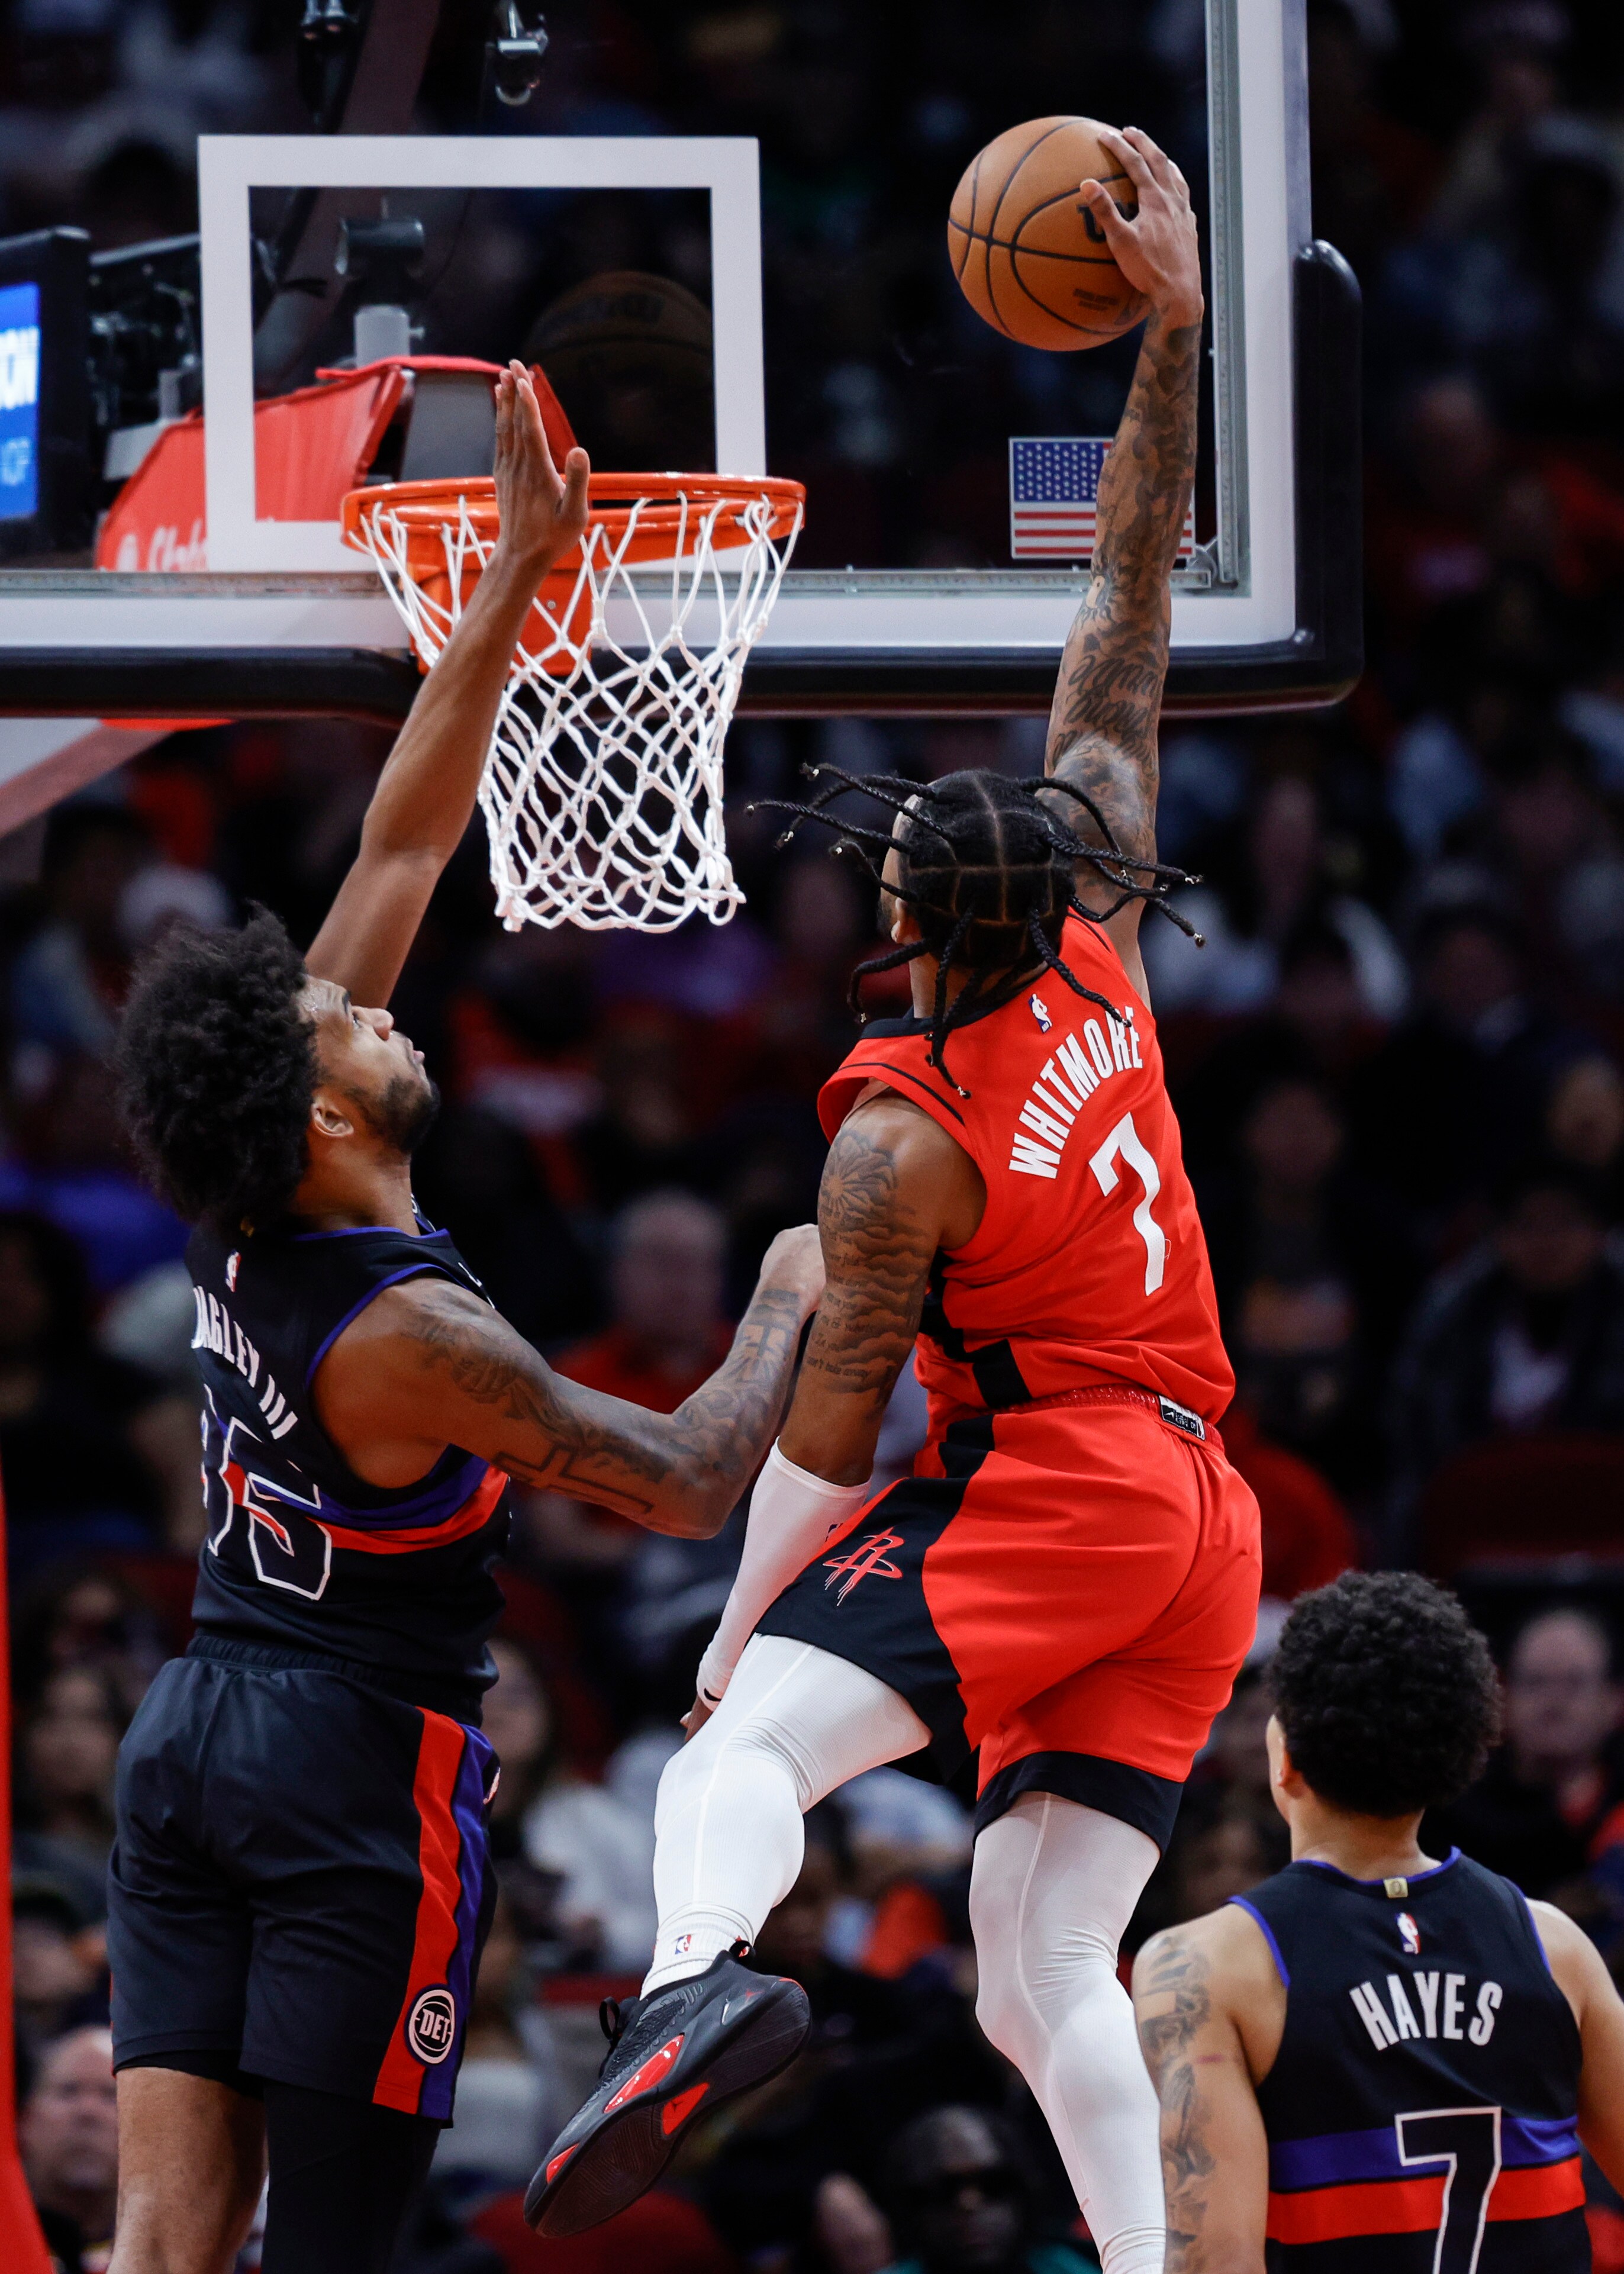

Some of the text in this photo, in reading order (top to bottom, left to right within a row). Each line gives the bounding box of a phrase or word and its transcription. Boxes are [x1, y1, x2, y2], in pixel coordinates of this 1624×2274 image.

[1008, 1006, 1143, 1179] WHITMORE
[1088, 1111, 1161, 1296] 7
[191, 1285, 260, 1389] AGLEY
[419, 2008, 450, 2044] DET
[1349, 1971, 1503, 2051] HAYES
[1395, 2106, 1501, 2274] 7
